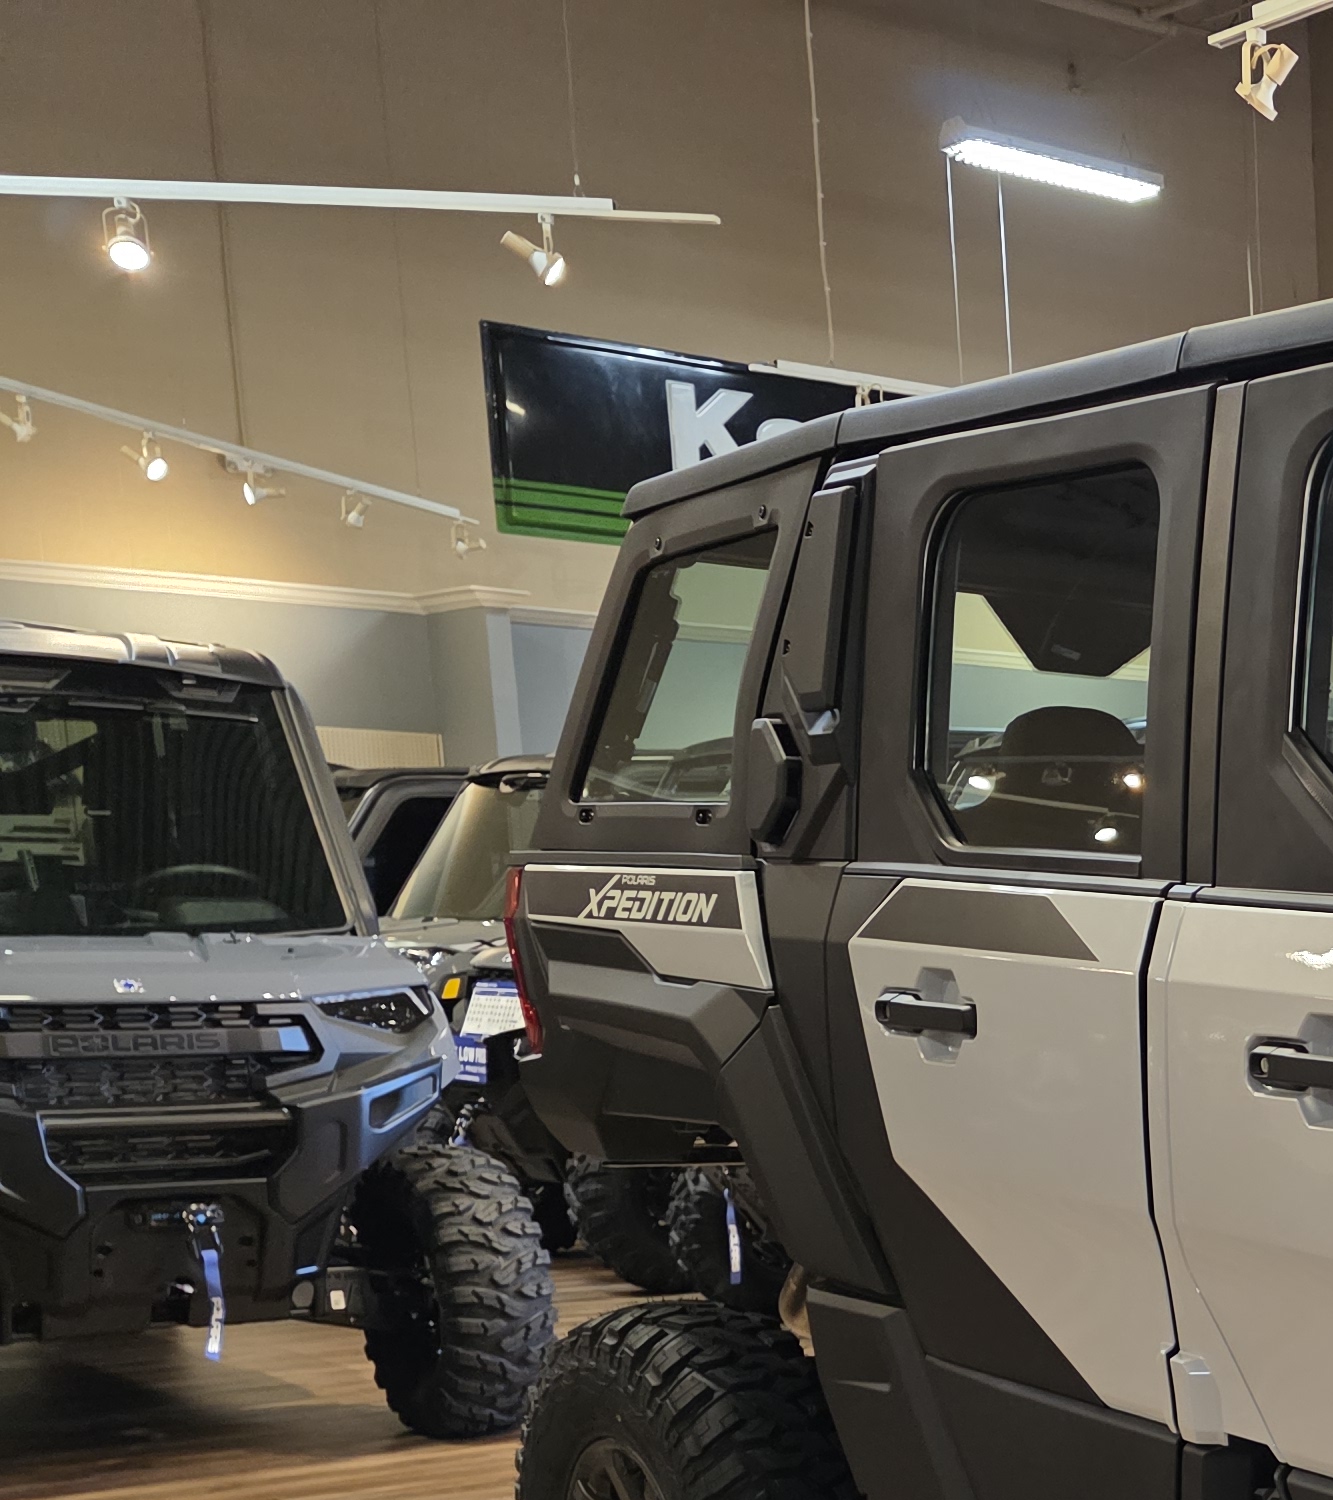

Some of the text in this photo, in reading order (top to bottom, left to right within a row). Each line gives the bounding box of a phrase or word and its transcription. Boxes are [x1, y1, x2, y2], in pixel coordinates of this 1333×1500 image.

[621, 874, 656, 886] POLARIS
[577, 874, 719, 924] XPEDITION
[51, 1033, 221, 1054] POLARIS
